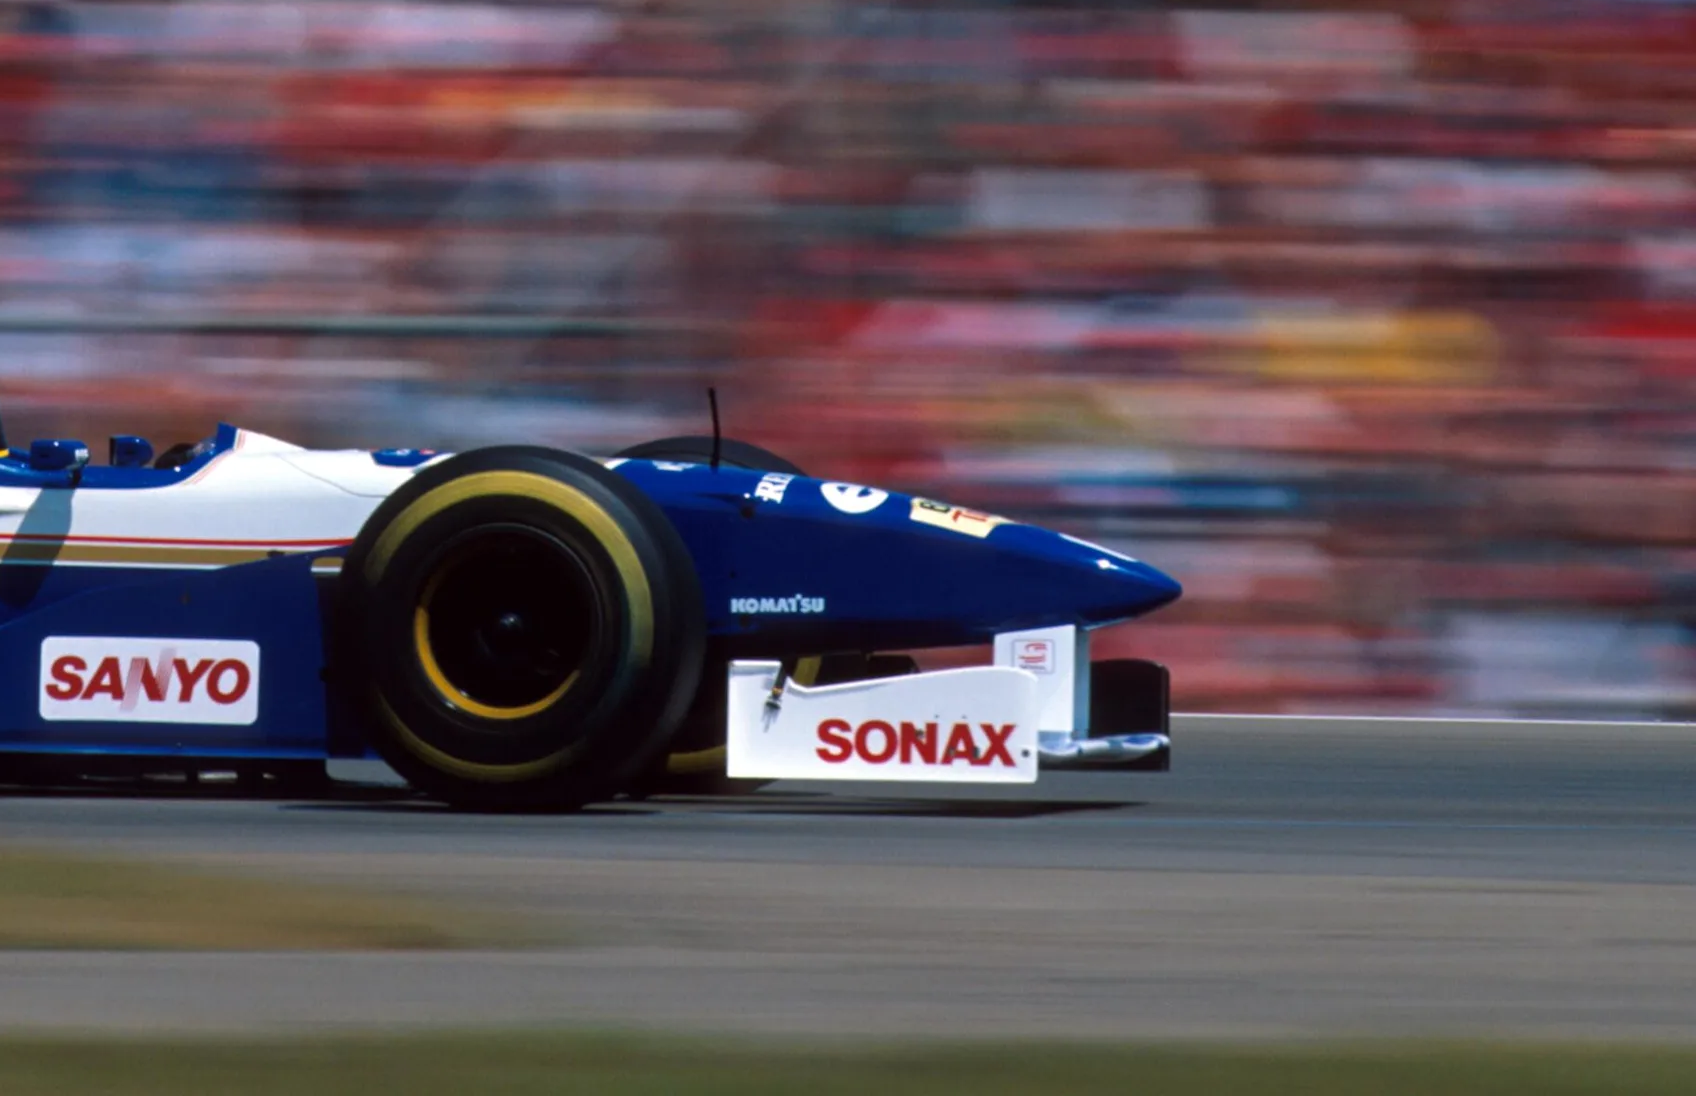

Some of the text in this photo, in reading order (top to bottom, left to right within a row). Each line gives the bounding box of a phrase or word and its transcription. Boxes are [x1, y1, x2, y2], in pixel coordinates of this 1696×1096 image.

[730, 593, 825, 614] KOMATSU
[45, 648, 252, 712] SANYO
[815, 718, 1018, 767] SONAX
